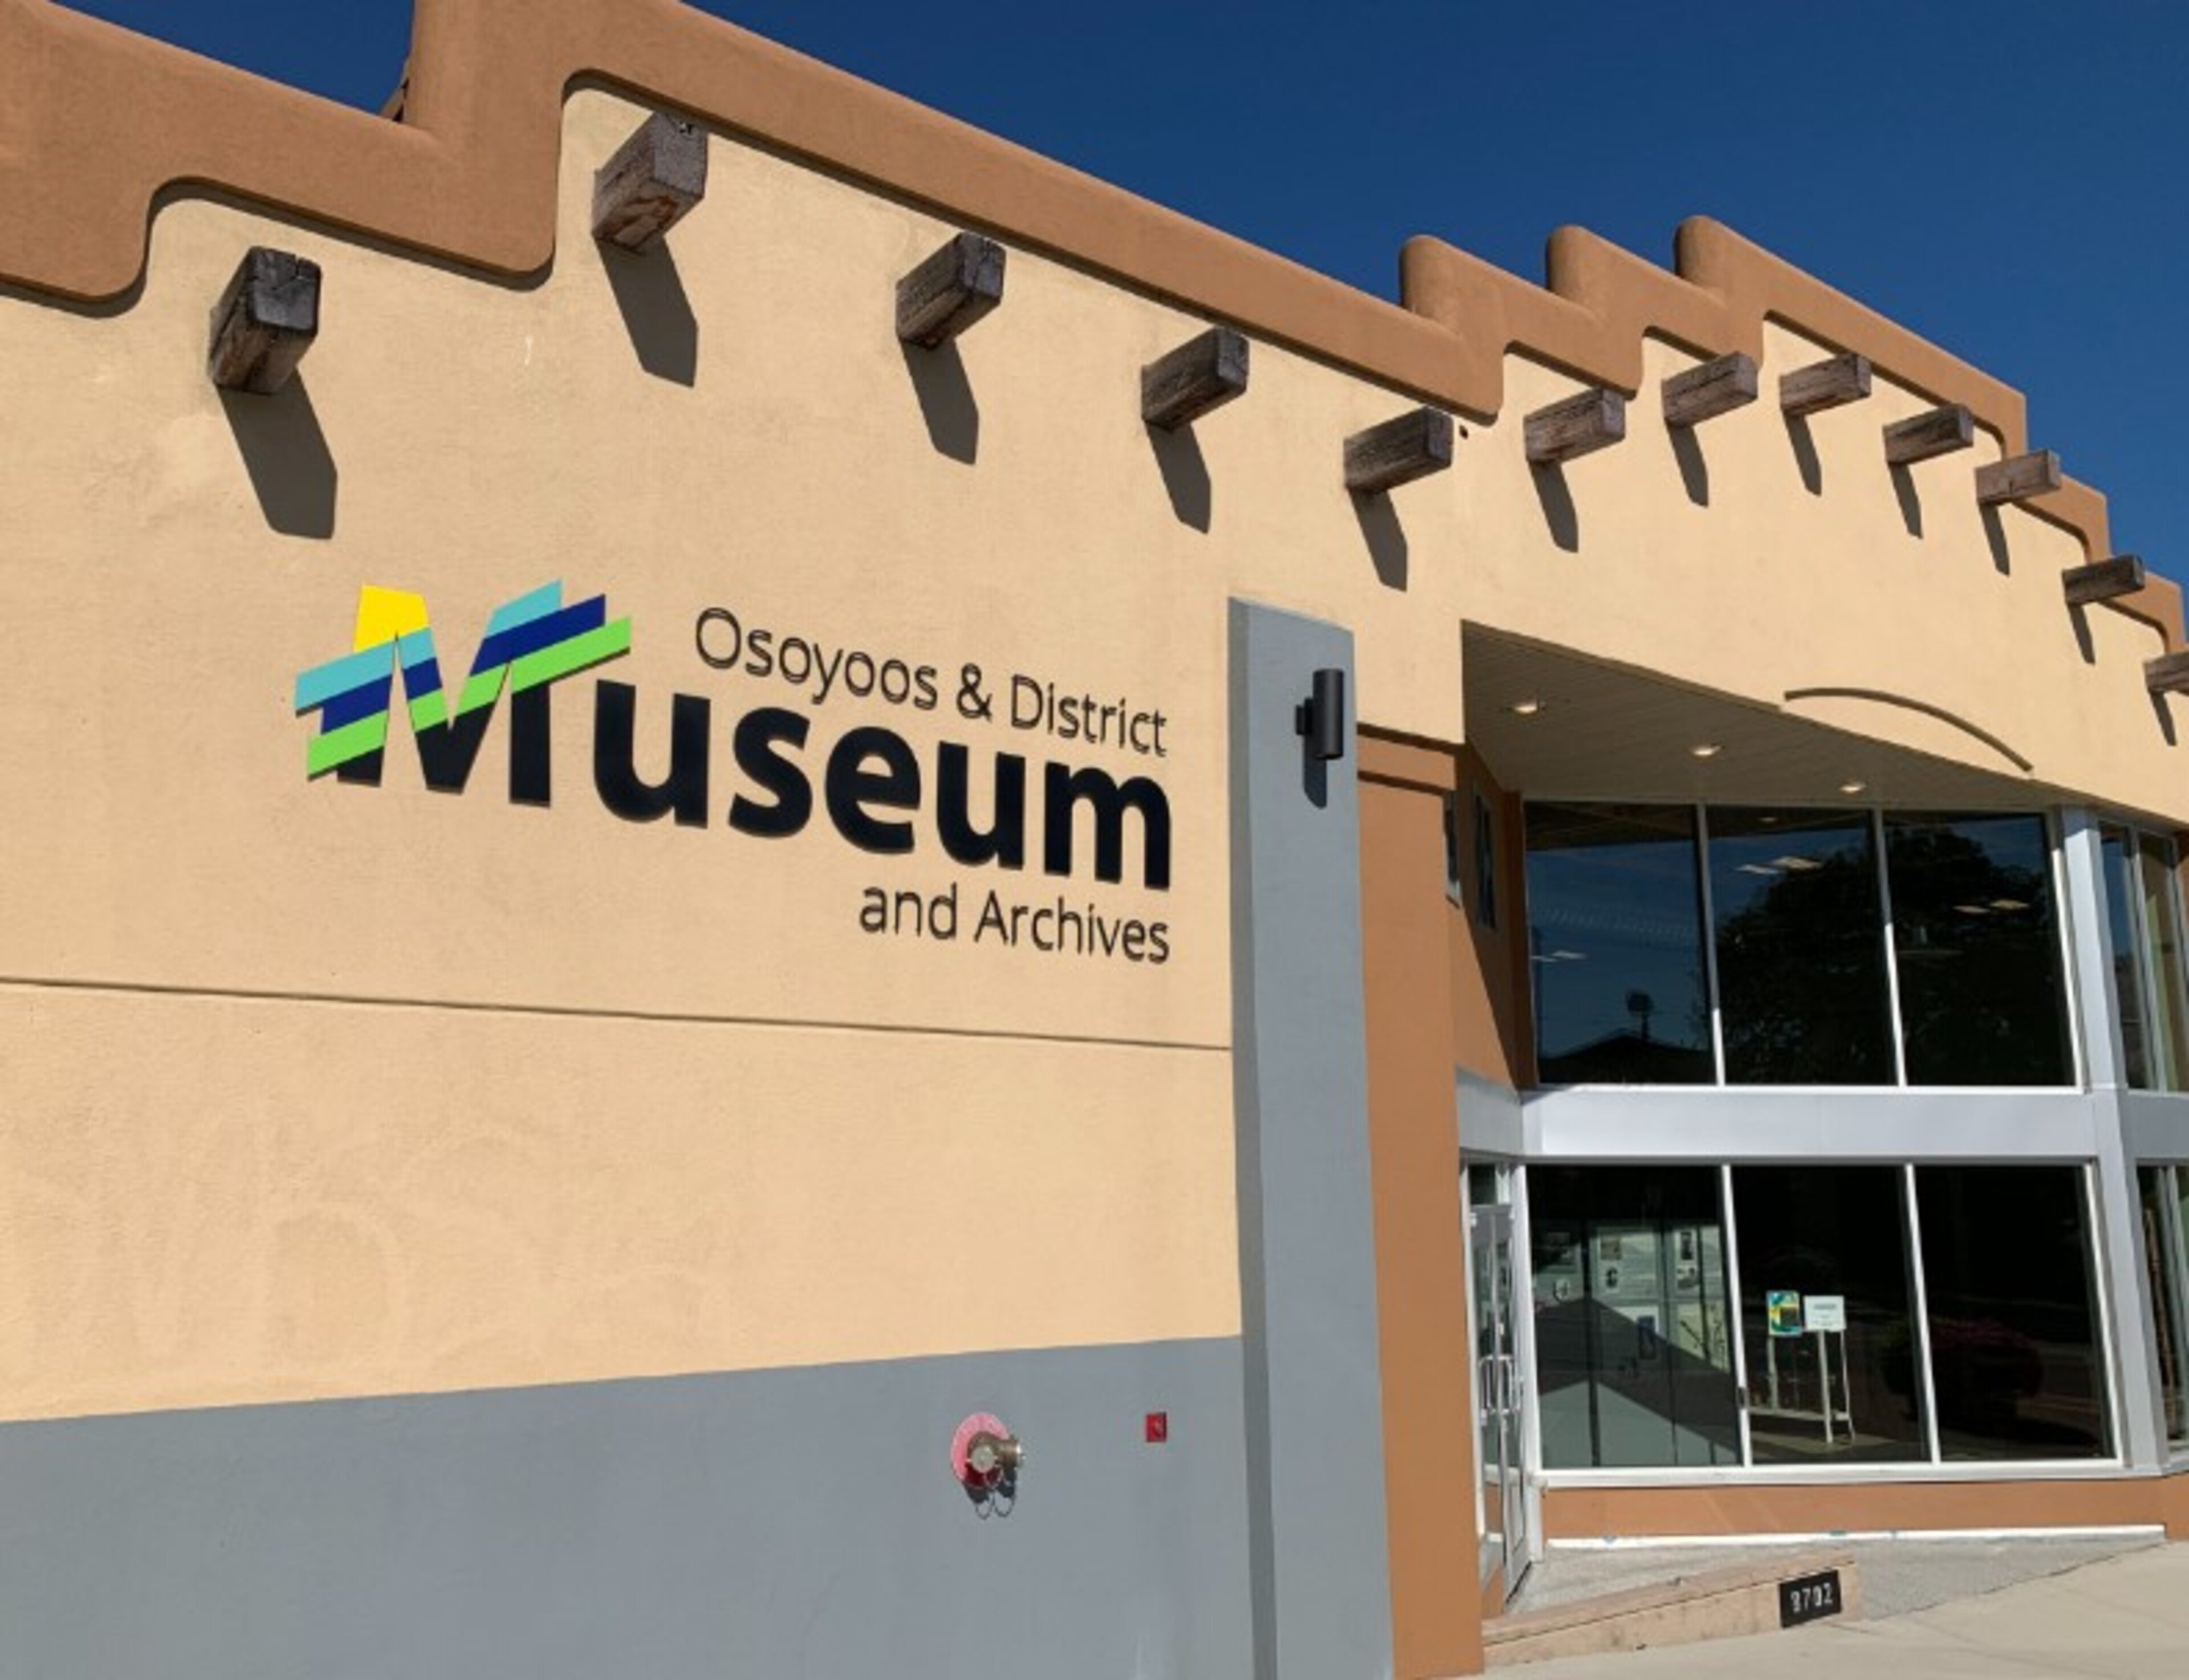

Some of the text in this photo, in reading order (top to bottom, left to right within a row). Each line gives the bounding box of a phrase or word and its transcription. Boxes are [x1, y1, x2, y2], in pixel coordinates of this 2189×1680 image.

[295, 580, 1171, 889] Museum
[695, 608, 1168, 757] Osoyoos & District
[860, 882, 1170, 963] and Archives
